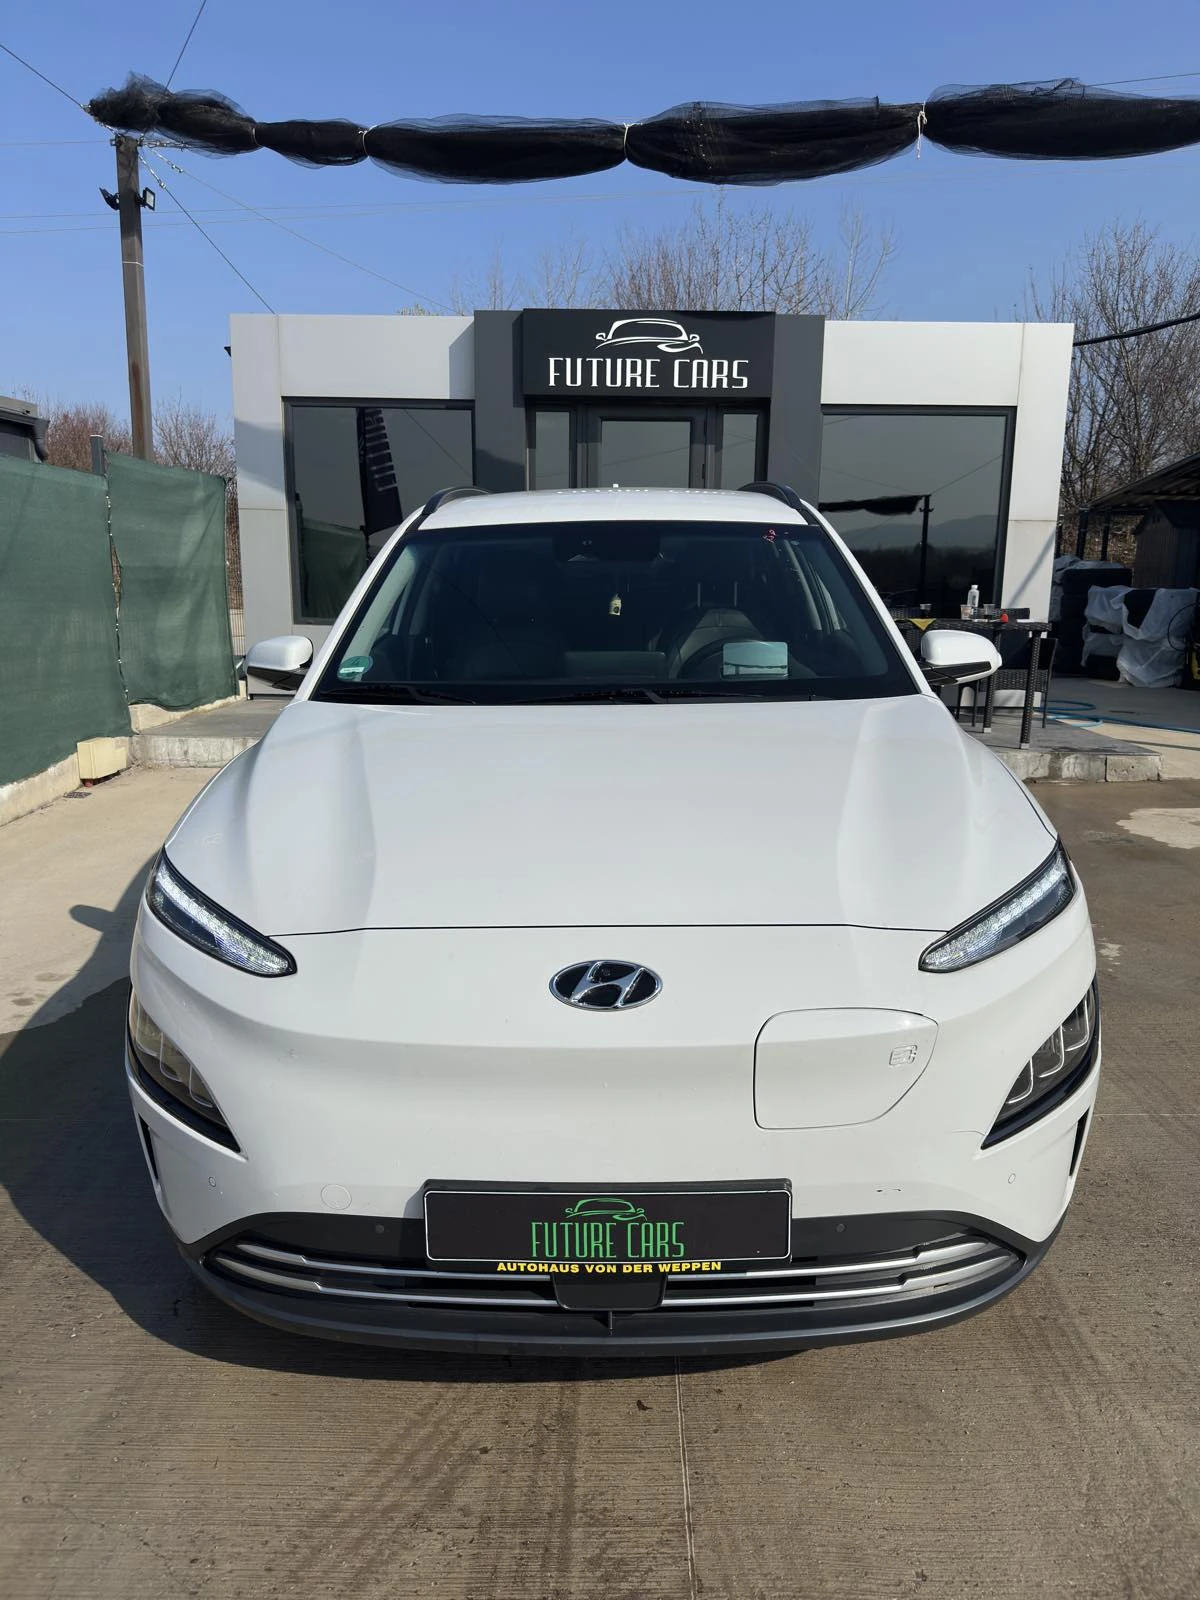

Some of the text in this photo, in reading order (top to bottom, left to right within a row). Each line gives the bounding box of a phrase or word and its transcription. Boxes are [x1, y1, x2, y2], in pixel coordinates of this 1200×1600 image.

[548, 357, 749, 389] FUTURE CARS
[530, 1221, 685, 1258] FUTURE CARS
[496, 1261, 722, 1274] AUTOHAUS VON DER WEPPEN
